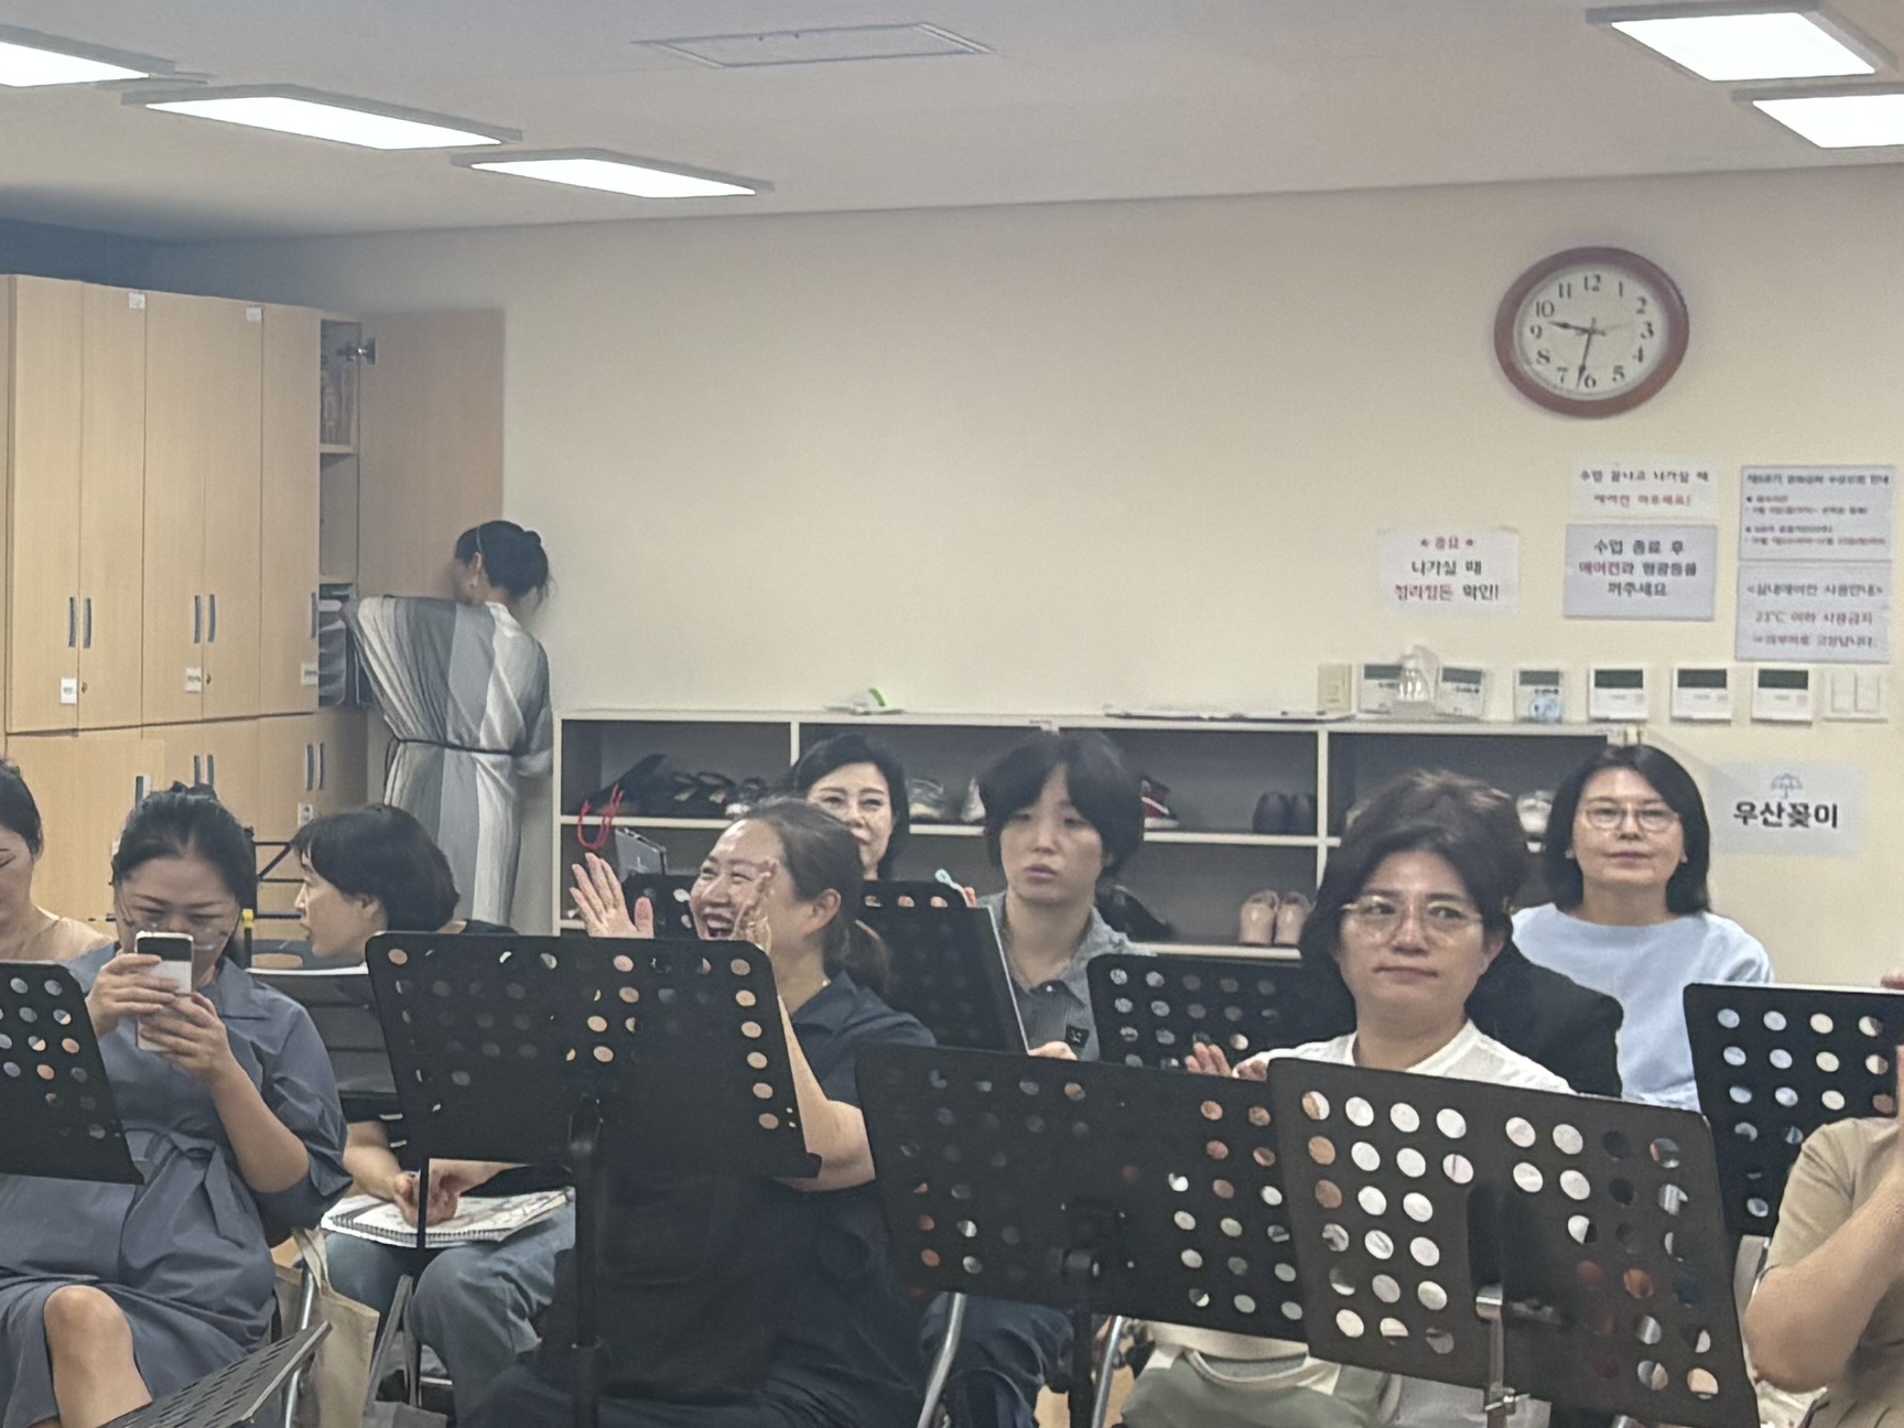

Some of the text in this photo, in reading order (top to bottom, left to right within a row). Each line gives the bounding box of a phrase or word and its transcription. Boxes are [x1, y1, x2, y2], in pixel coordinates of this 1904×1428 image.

[1558, 282, 1571, 299] 11
[1584, 274, 1601, 291] 12
[1536, 300, 1555, 318] 10
[1636, 296, 1647, 314] 2
[1530, 325, 1542, 339] 9
[1640, 321, 1654, 339] 3
[1536, 349, 1550, 364] 8
[1632, 346, 1643, 363] 4
[1556, 367, 1568, 384] 7
[1584, 375, 1596, 389] 6
[1612, 365, 1625, 382] 5
[1594, 539, 1623, 555] 수업
[1633, 540, 1661, 555] 종료
[1411, 560, 1482, 576] 나가실 때
[1463, 583, 1499, 601] 확인!
